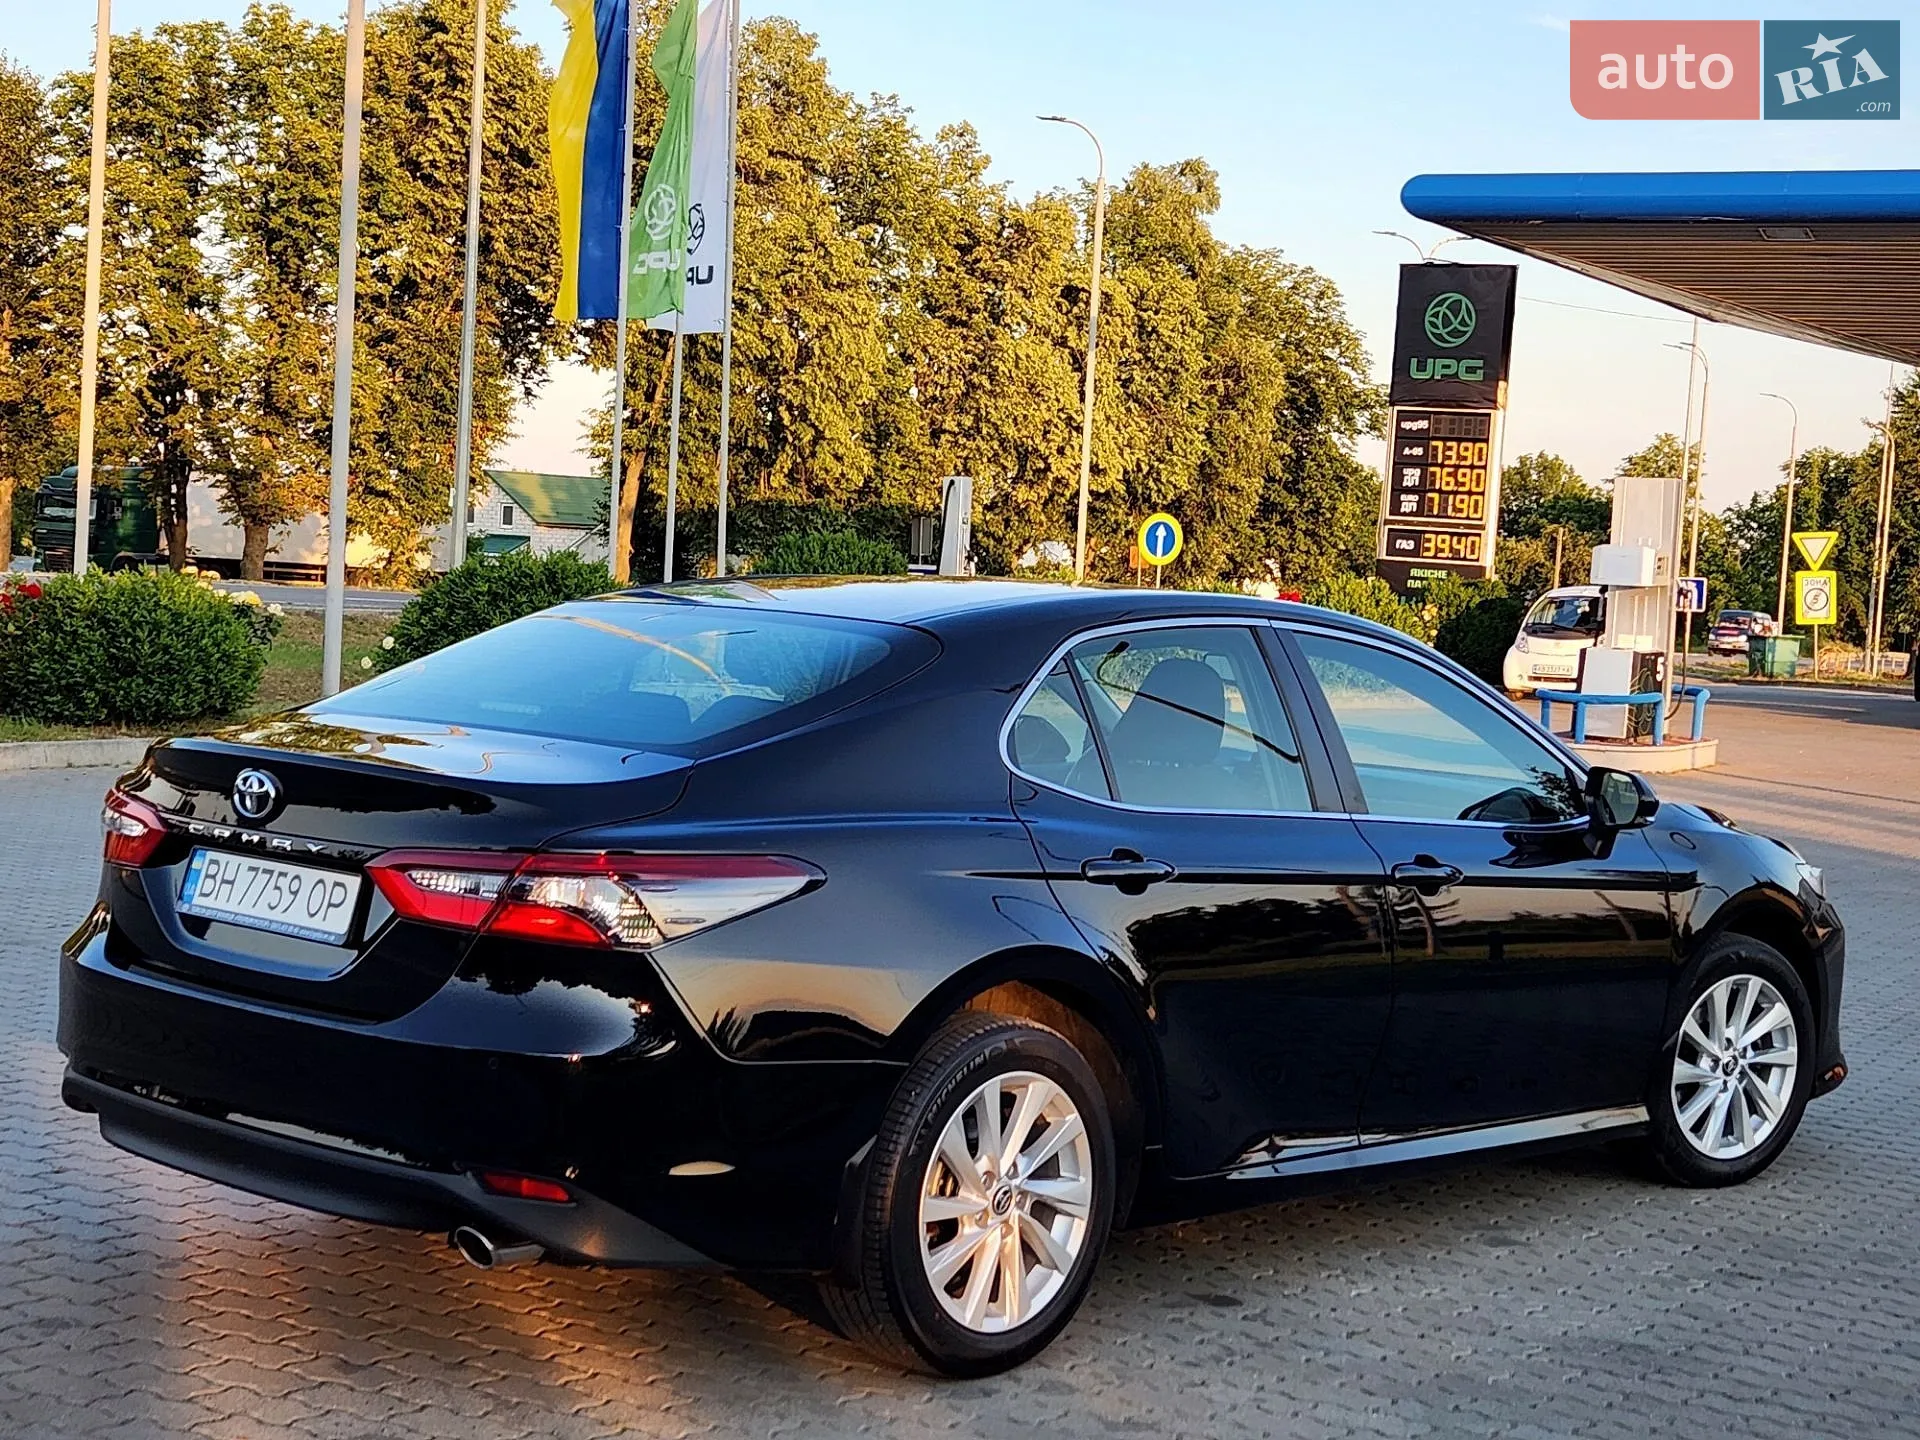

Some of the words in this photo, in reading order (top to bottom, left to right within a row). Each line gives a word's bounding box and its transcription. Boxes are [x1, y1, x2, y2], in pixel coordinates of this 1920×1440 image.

[1409, 358, 1484, 380] UPG
[1400, 420, 1429, 431] upg95
[1431, 441, 1488, 466] 73.90
[1428, 466, 1486, 492] 76.90
[1426, 492, 1484, 519] 71.90
[1395, 539, 1415, 550] ГАЗ
[1422, 533, 1480, 560] 39.40
[1410, 568, 1448, 579] ЯКІСНЕ
[199, 858, 242, 901] BH
[238, 865, 302, 914] 7759
[306, 878, 348, 922] OP
[927, 1050, 985, 1124] MICHELIN
